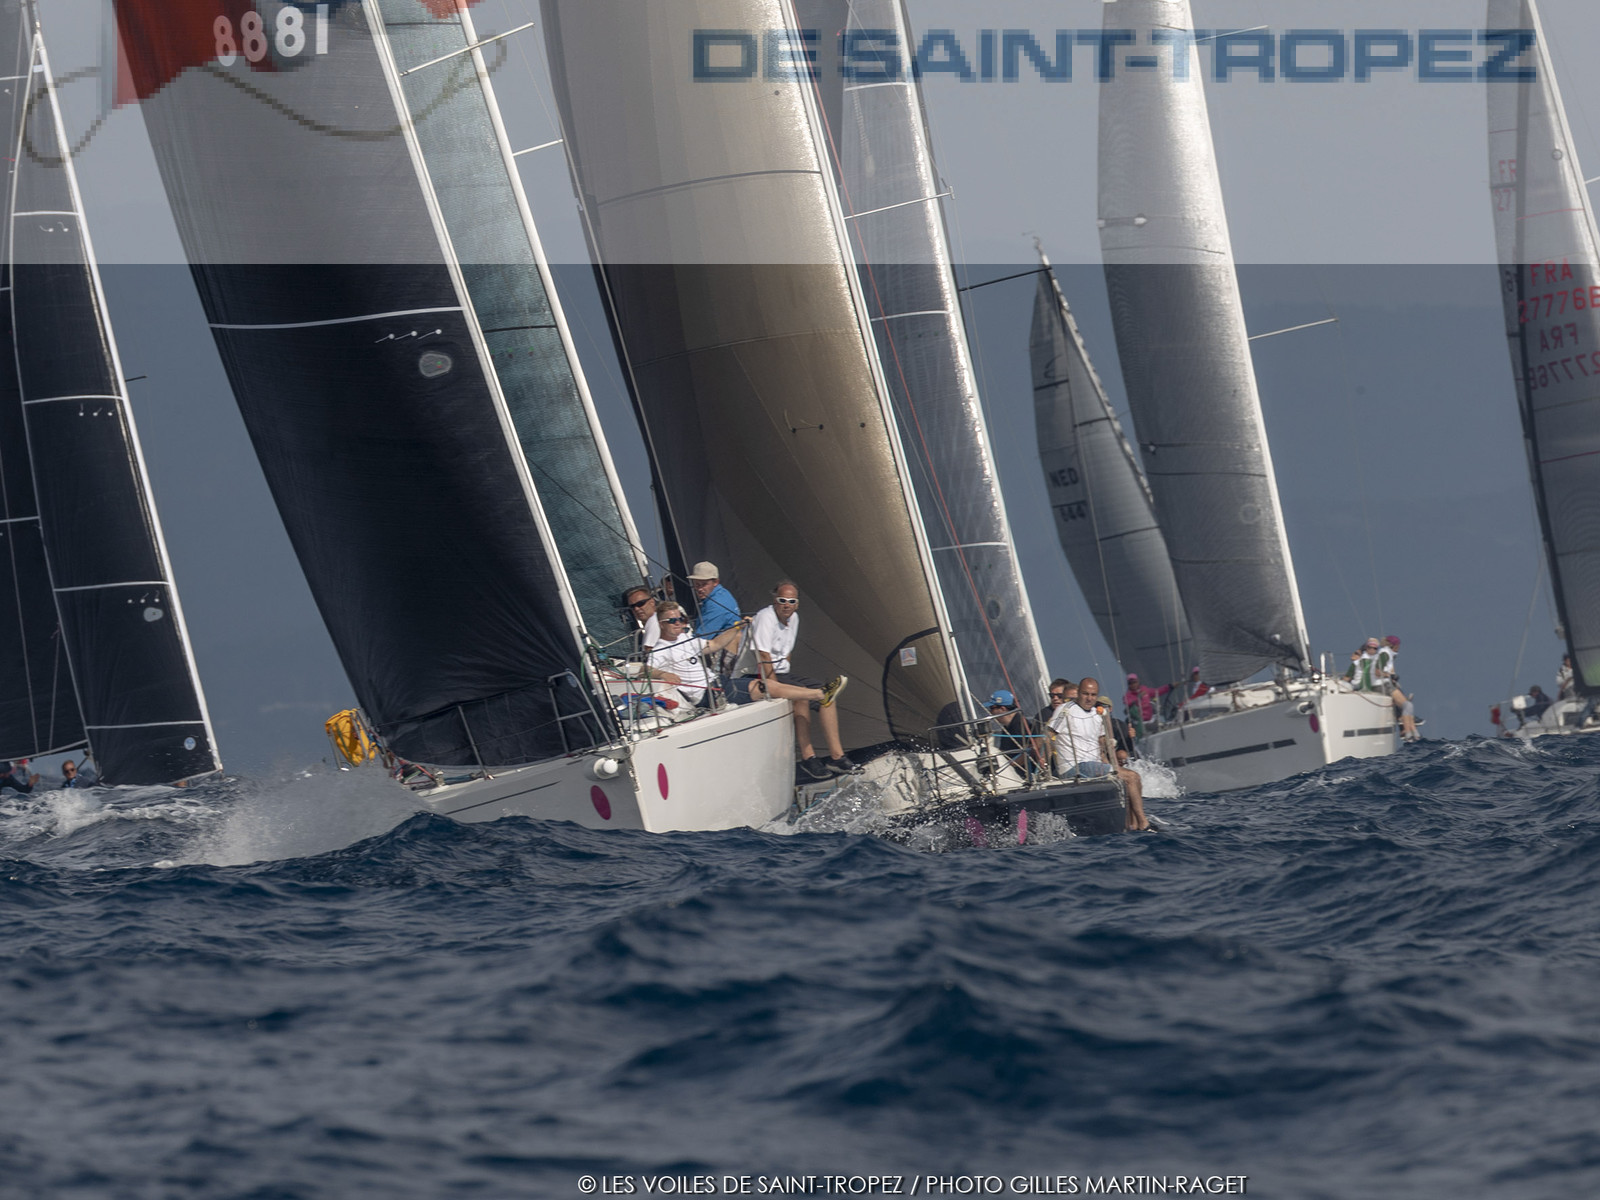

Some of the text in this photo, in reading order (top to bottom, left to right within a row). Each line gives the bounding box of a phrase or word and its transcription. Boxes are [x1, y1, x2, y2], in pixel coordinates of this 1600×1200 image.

[213, 4, 329, 66] 8881
[1530, 257, 1574, 287] FRA
[1049, 467, 1079, 488] NED
